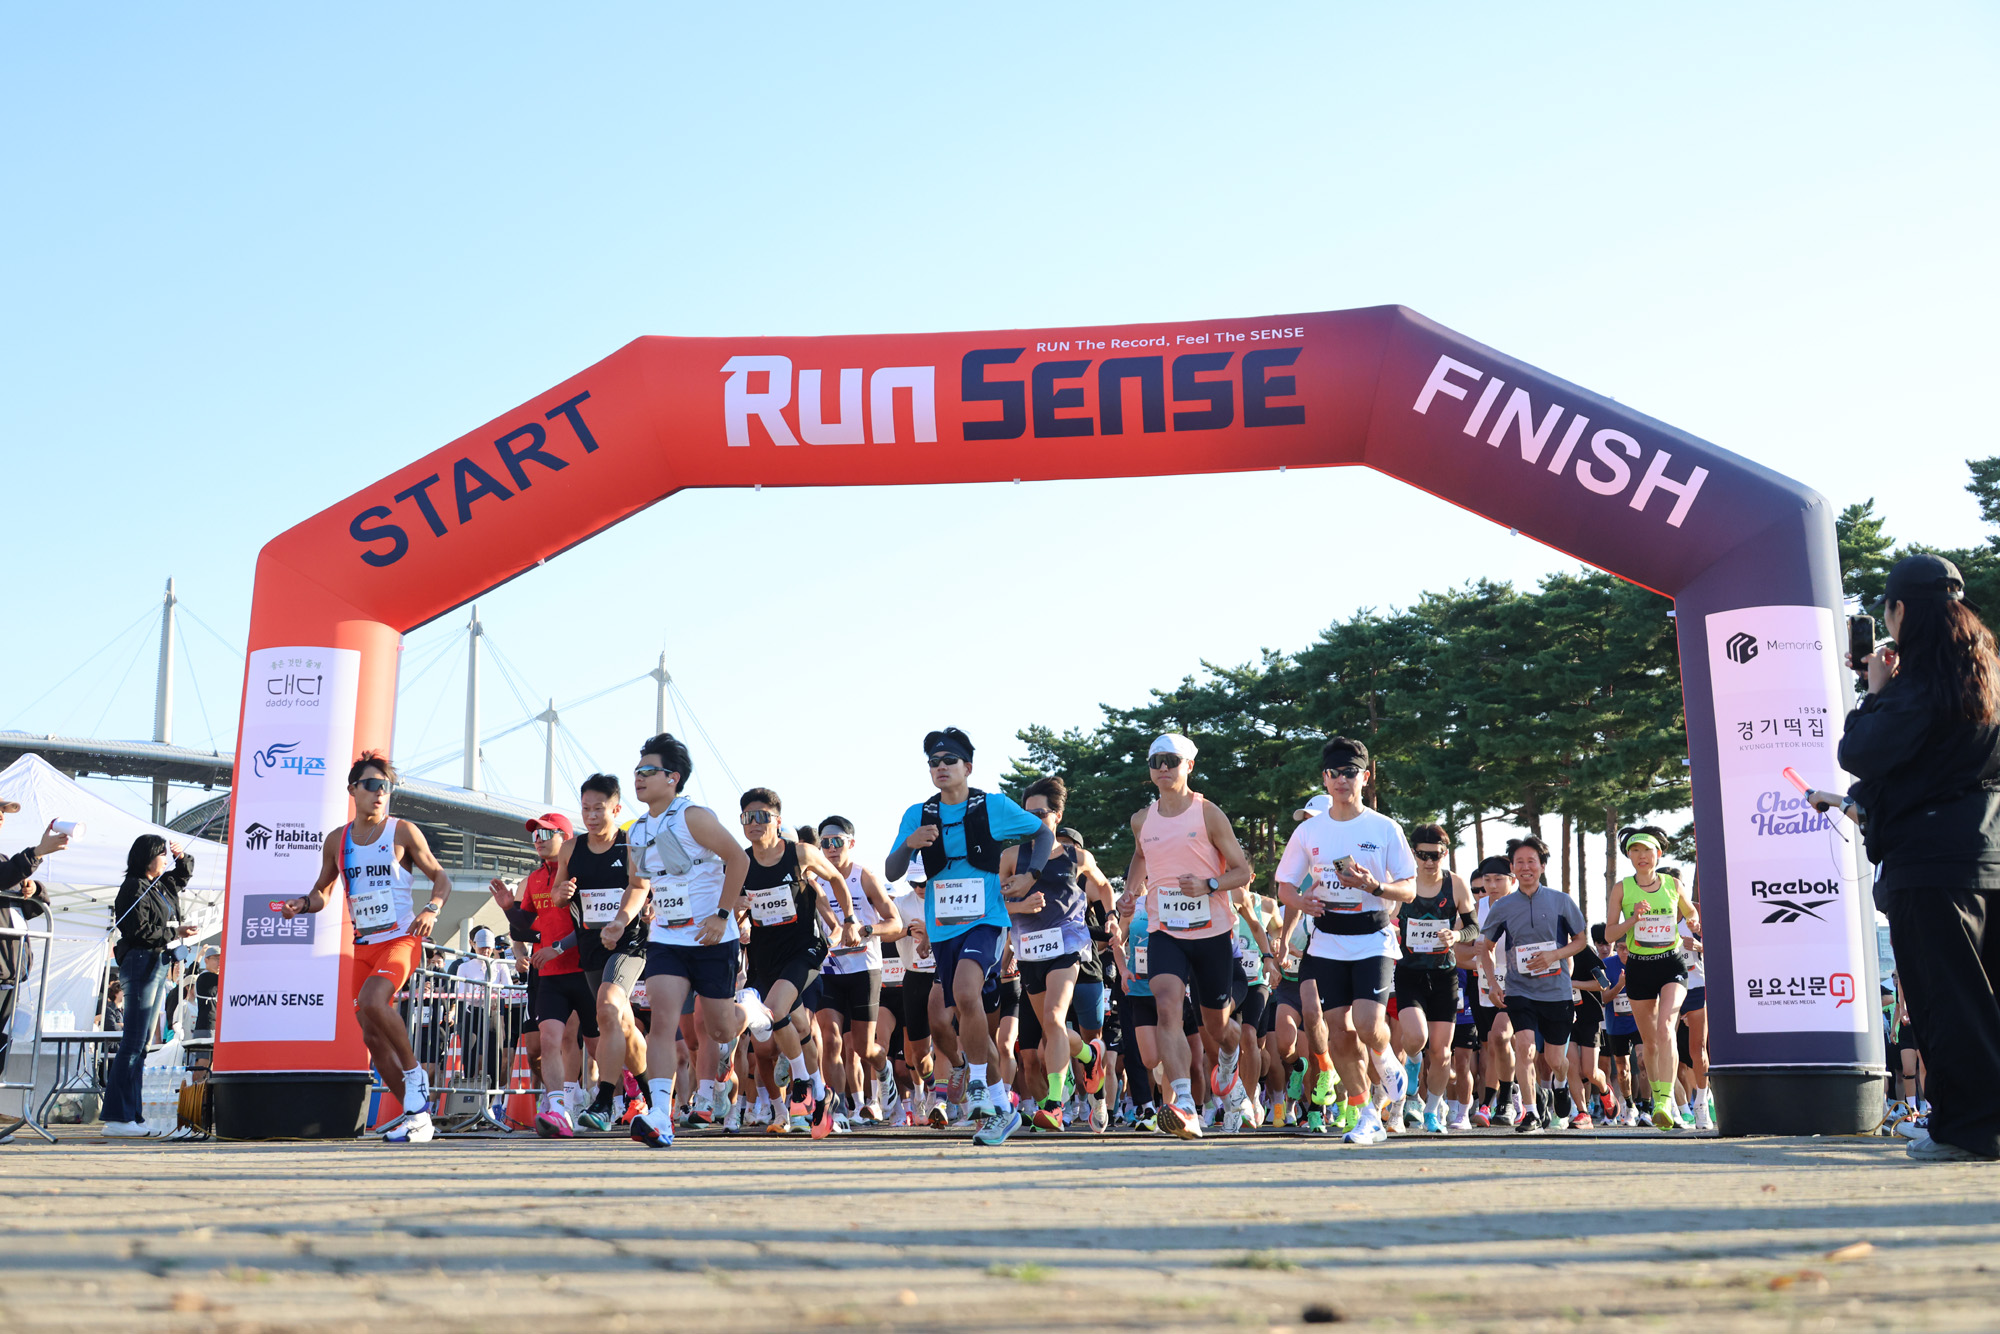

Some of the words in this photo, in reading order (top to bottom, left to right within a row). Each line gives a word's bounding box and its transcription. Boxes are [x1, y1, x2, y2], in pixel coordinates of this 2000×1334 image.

[1036, 341, 1070, 352] RUN
[1075, 340, 1106, 350] The
[1110, 336, 1170, 348] Record,
[1176, 334, 1209, 345] Feel
[1214, 332, 1246, 343] The
[1250, 327, 1305, 340] SENSE
[1412, 354, 1709, 528] FINISH
[349, 389, 600, 568] START
[1767, 640, 1823, 650] MemorinG
[267, 674, 323, 696] 대디
[265, 698, 294, 708] daddy
[295, 698, 320, 706] food
[1739, 742, 1774, 751] KYUNGGI
[280, 756, 327, 776] 피죤
[1750, 811, 1831, 836] Health
[275, 830, 324, 842] Habitat
[287, 843, 323, 852] Humanity
[342, 866, 362, 878] TOP
[366, 865, 391, 877] RUN
[1751, 878, 1840, 898] Reebok
[658, 897, 684, 908] 1234
[761, 898, 787, 910] 1095
[949, 894, 977, 904] 1411
[1173, 900, 1202, 911] 1061
[364, 903, 389, 916] 1199
[594, 902, 620, 911] 1806
[246, 917, 310, 939] 동원샘물
[1032, 941, 1059, 954] 1784
[1638, 952, 1669, 961] DESCENTE
[1748, 976, 1828, 998] 일요신문
[229, 994, 278, 1007] WOMAN
[281, 994, 324, 1006] SENSE
